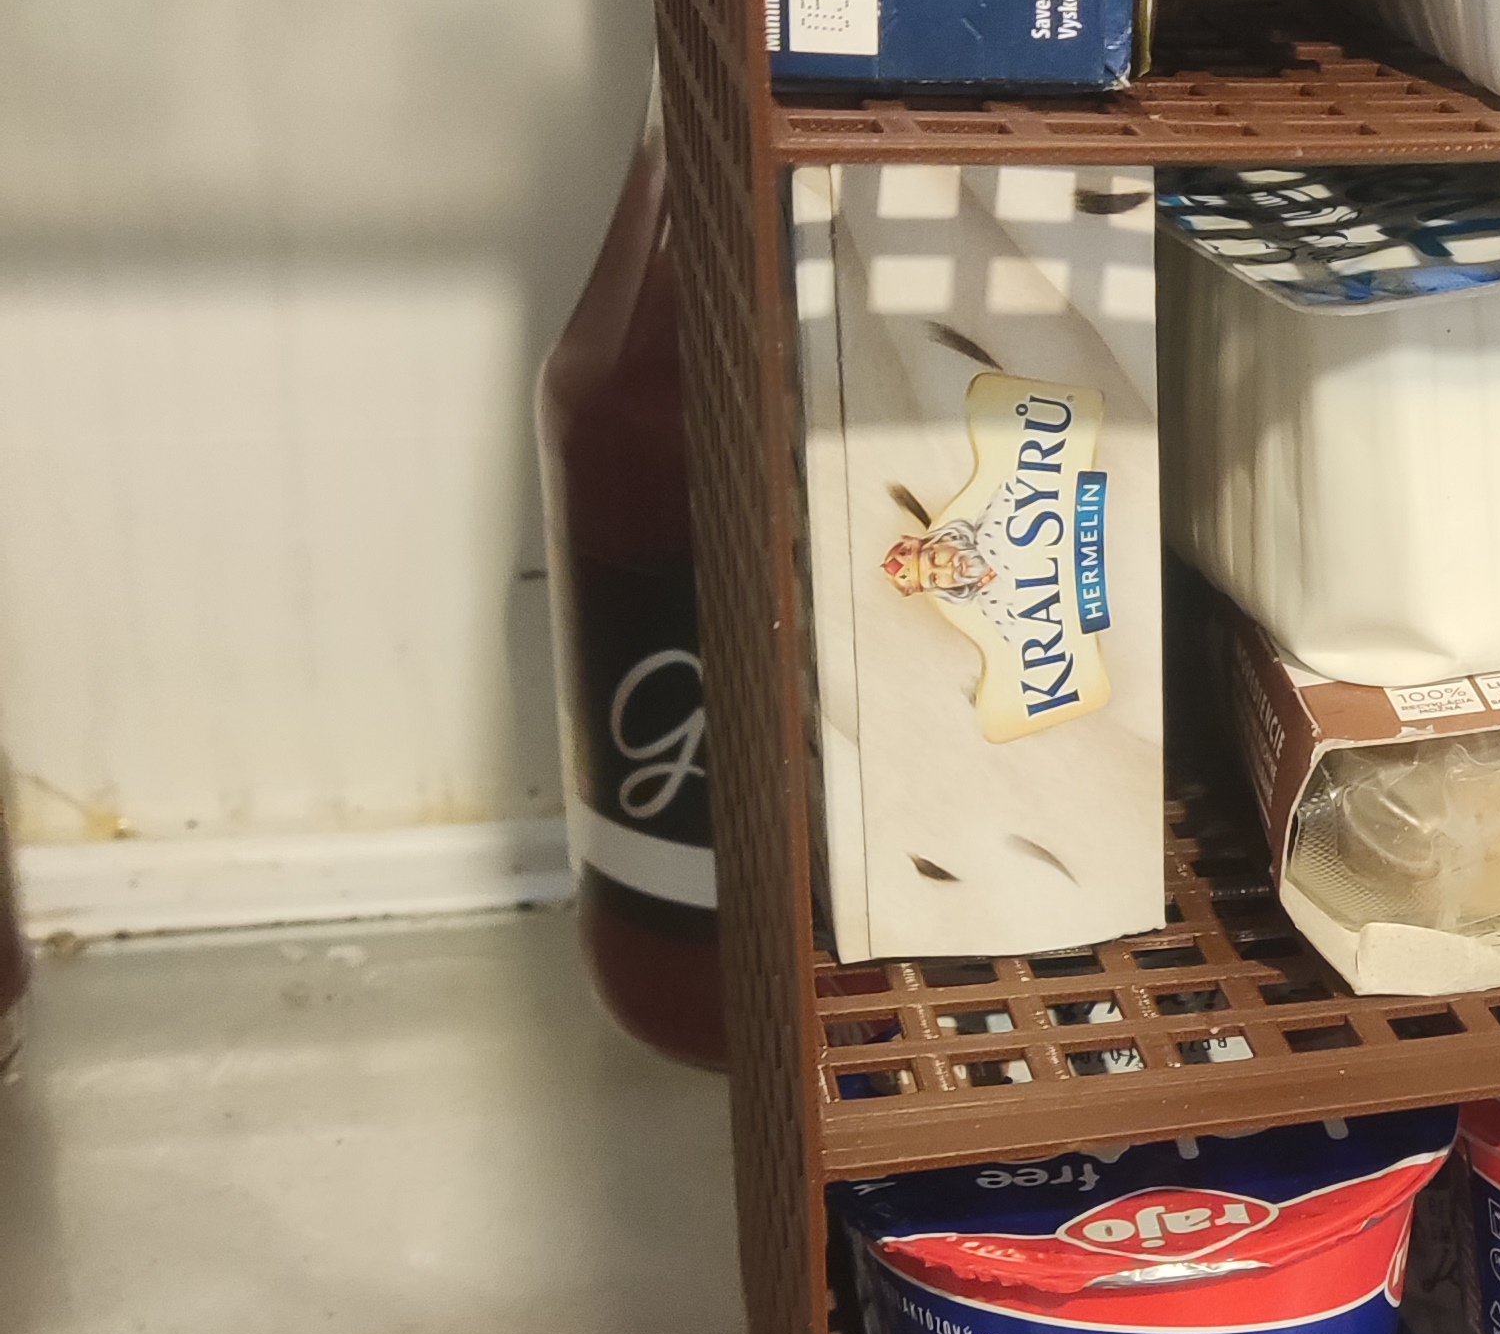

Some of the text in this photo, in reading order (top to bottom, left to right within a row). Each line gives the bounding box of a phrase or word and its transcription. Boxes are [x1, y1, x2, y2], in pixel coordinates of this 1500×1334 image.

[1005, 394, 1081, 718] KRÁL SÝRŮ
[1075, 482, 1105, 621] HERMELÍN
[1396, 686, 1468, 705] 100%
[974, 1162, 1102, 1193] free
[1080, 1202, 1253, 1250] rajo
